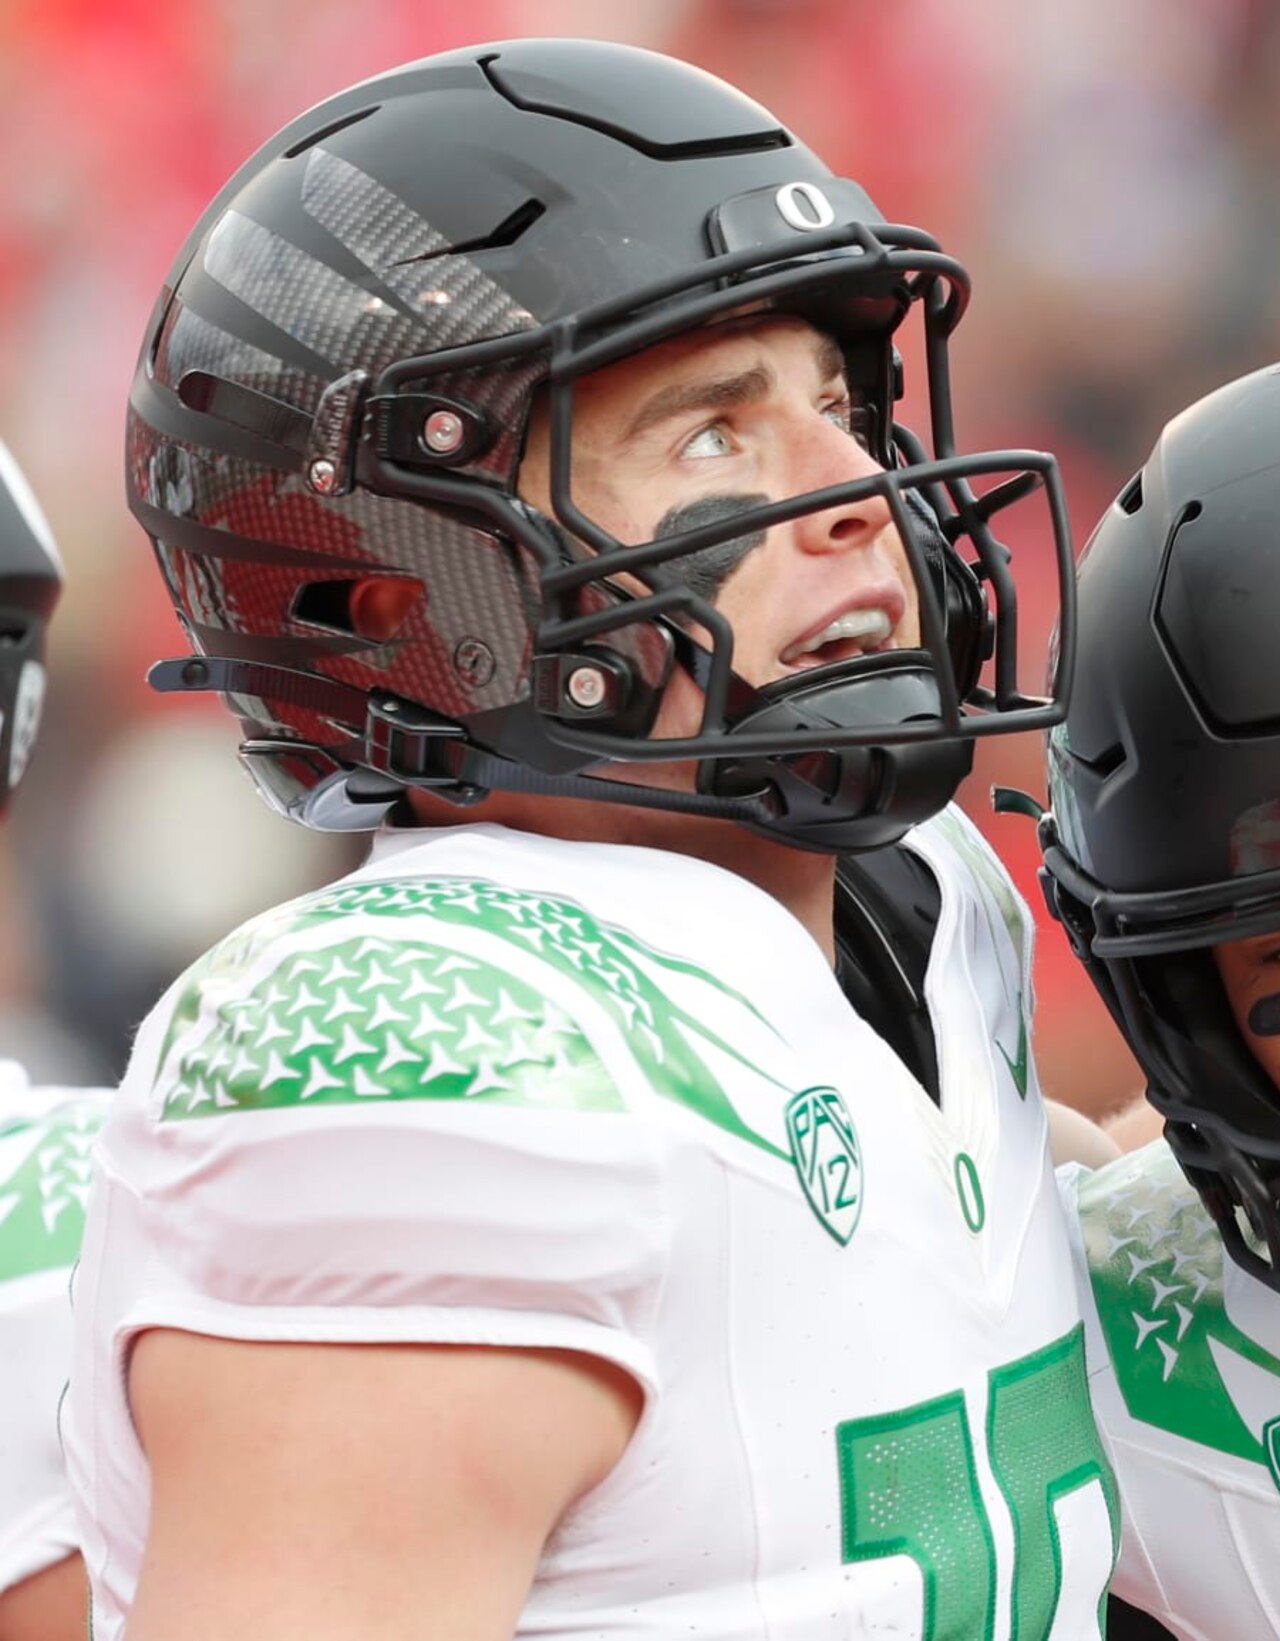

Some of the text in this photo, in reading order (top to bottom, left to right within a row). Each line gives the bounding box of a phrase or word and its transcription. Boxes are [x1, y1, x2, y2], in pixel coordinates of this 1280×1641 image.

[776, 181, 834, 229] O
[794, 1093, 858, 1187] PAC
[818, 1154, 857, 1214] 12
